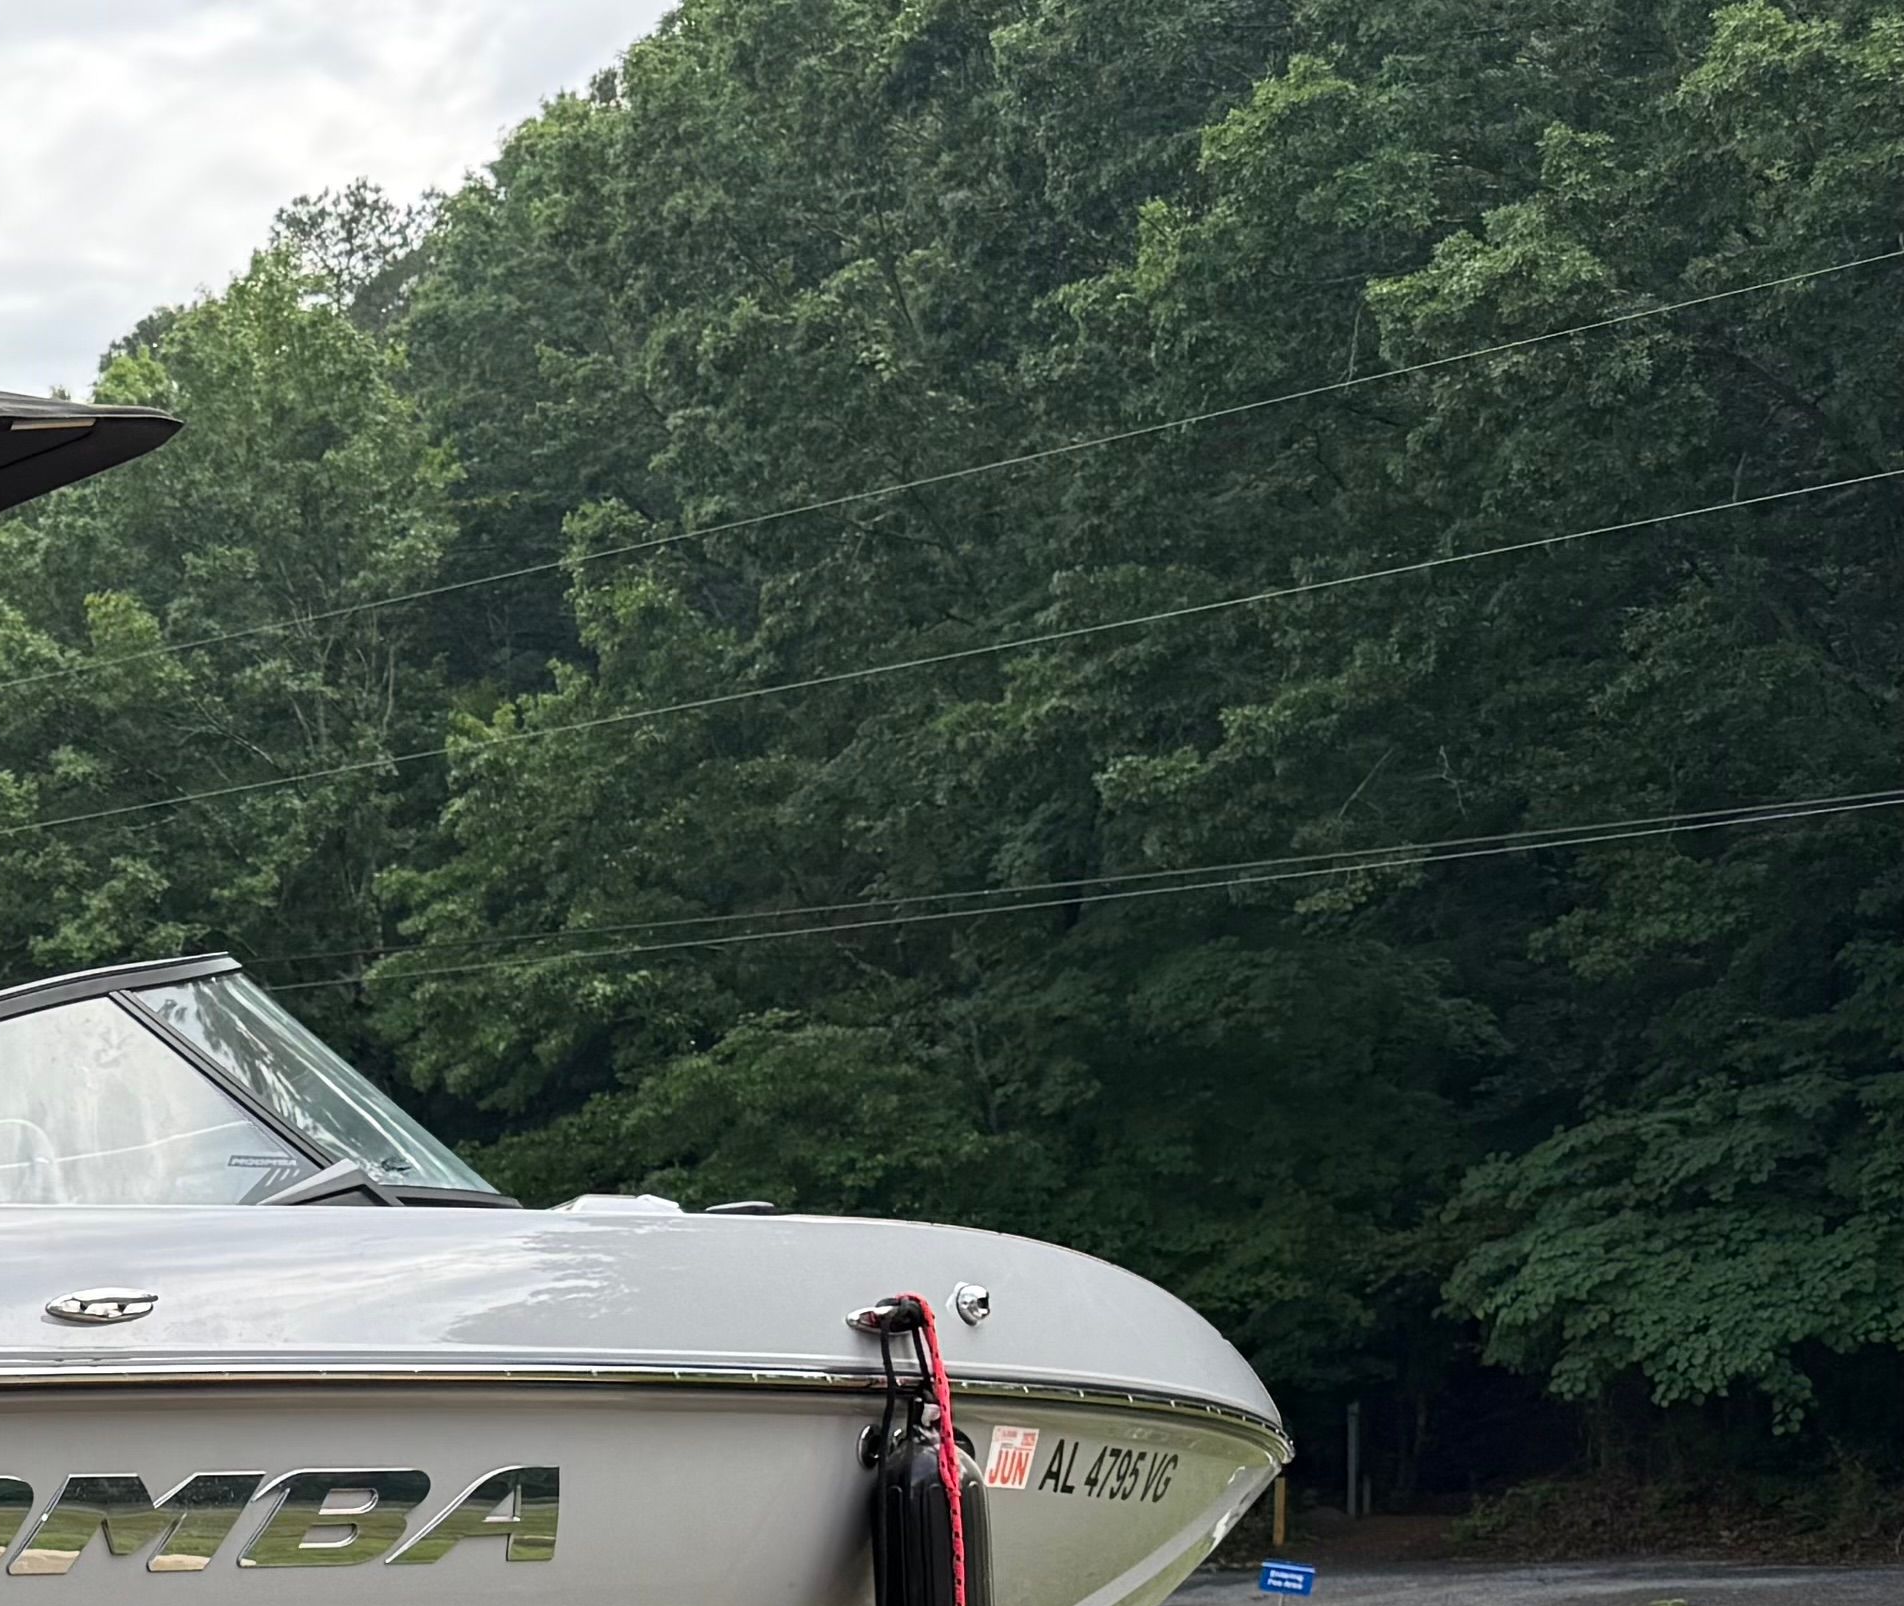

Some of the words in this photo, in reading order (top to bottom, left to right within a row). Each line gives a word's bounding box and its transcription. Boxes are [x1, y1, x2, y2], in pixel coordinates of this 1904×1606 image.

[988, 1449, 1030, 1487] JUN
[1038, 1438, 1079, 1495] AL
[1083, 1445, 1141, 1502] 4795
[1139, 1451, 1180, 1503] VG
